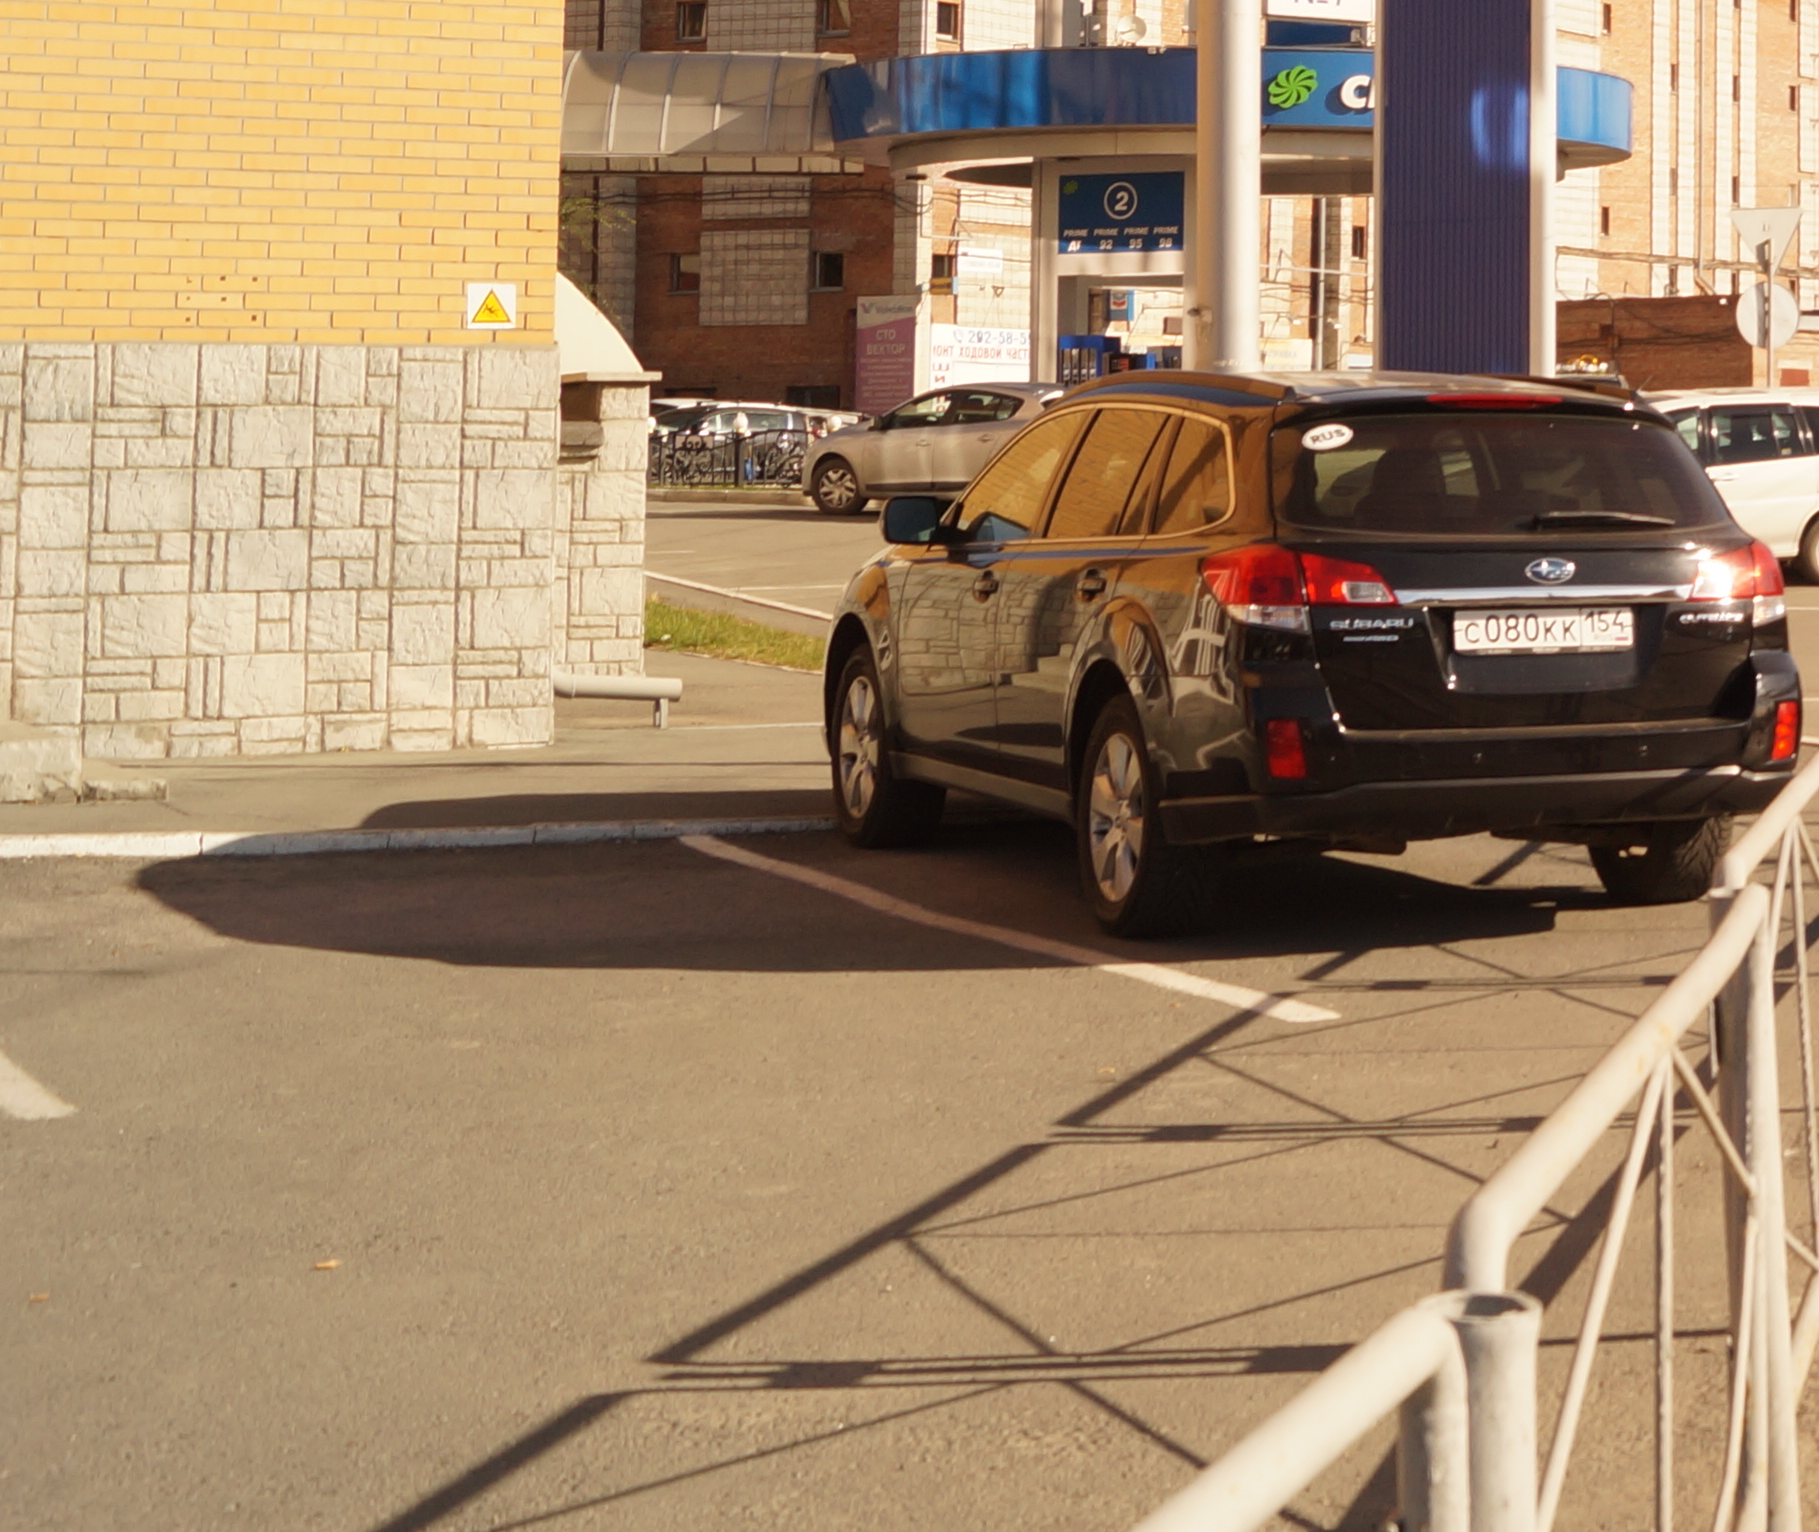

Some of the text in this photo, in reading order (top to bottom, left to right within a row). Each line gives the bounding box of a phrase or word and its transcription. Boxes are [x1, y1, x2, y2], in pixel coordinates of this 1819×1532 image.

[1114, 191, 1129, 211] 2
[1063, 226, 1178, 237] PRIME PRIME PRIME PRIME
[1099, 239, 1113, 250] 92
[1128, 238, 1143, 249] 95
[1158, 237, 1173, 248] 98
[876, 329, 896, 340] СТО
[866, 343, 906, 355] ВЕКТОР
[1006, 348, 1029, 360] ЧАСТ
[1310, 429, 1346, 445] RUS
[1329, 618, 1414, 631] SUBARU
[1584, 610, 1625, 633] 154
